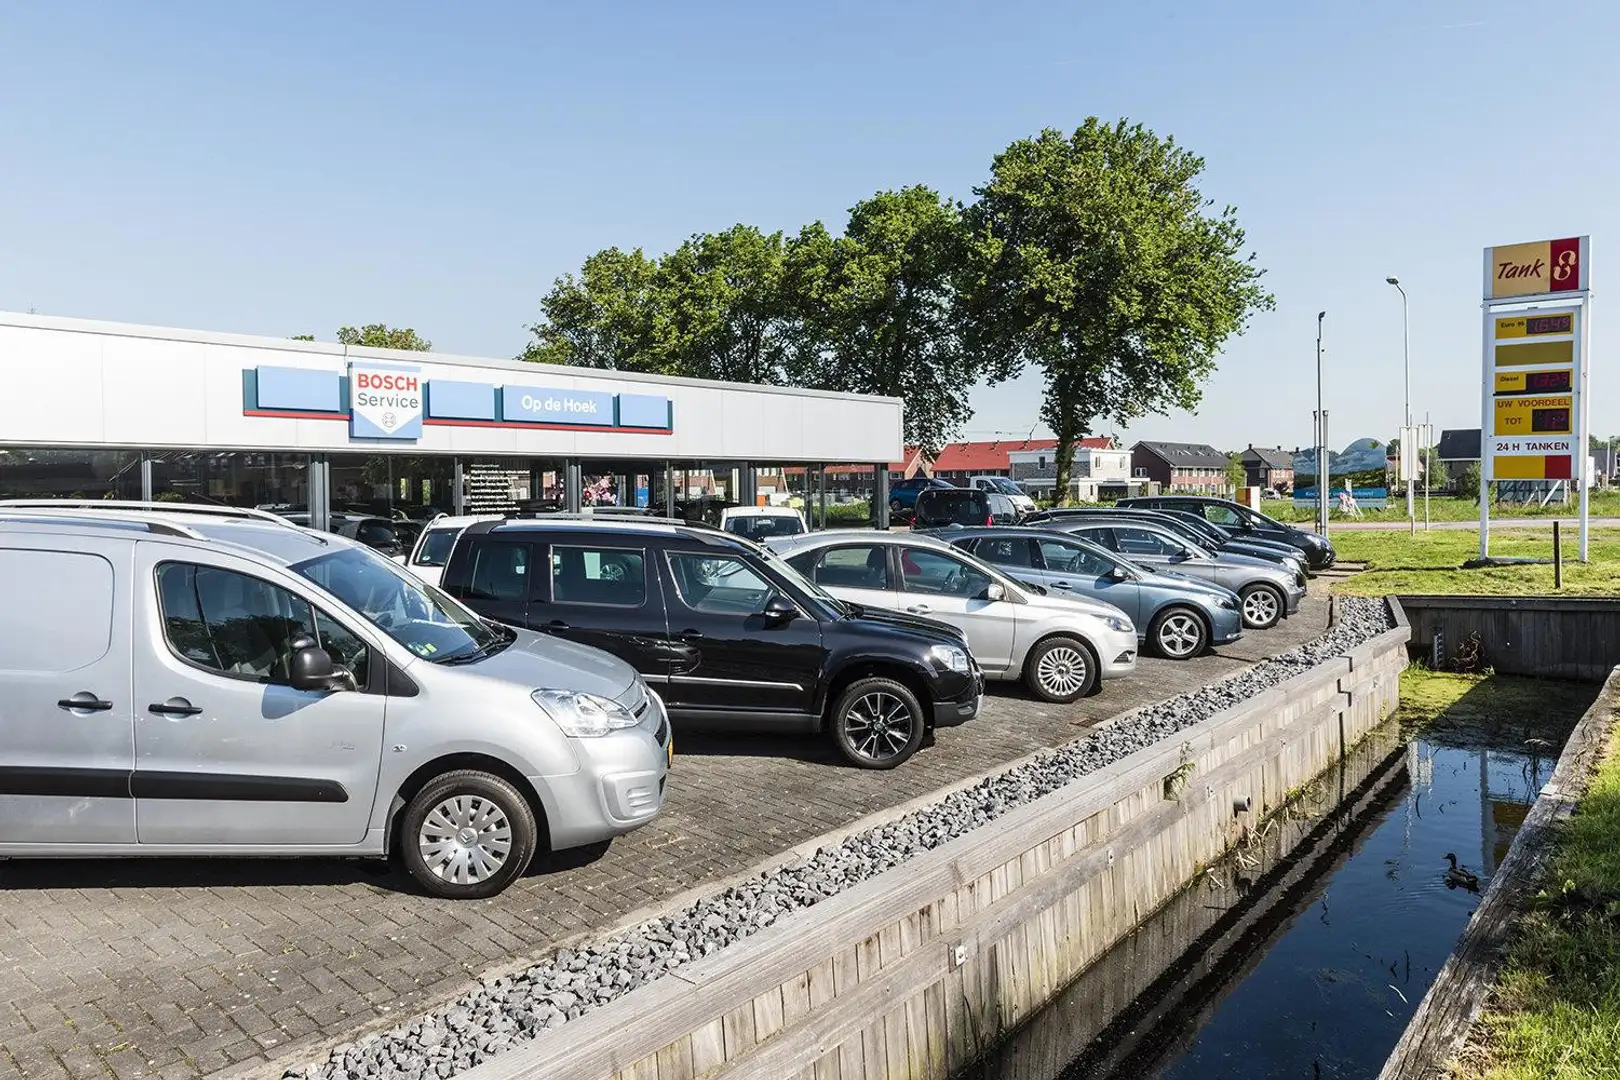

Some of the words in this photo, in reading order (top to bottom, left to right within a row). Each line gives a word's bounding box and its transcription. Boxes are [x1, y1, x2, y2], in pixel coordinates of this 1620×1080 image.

[1498, 259, 1545, 280] Tank
[358, 373, 417, 391] BOSCH
[357, 392, 419, 409] Service
[521, 394, 542, 412] Op
[544, 396, 561, 411] de
[563, 397, 597, 413] Hoek
[1497, 400, 1513, 408] UW
[1518, 399, 1569, 408] VOORDEEL
[1504, 417, 1523, 425] TOT
[1496, 442, 1509, 451] 24
[1512, 443, 1520, 451] H
[1525, 442, 1569, 451] TANKEN
